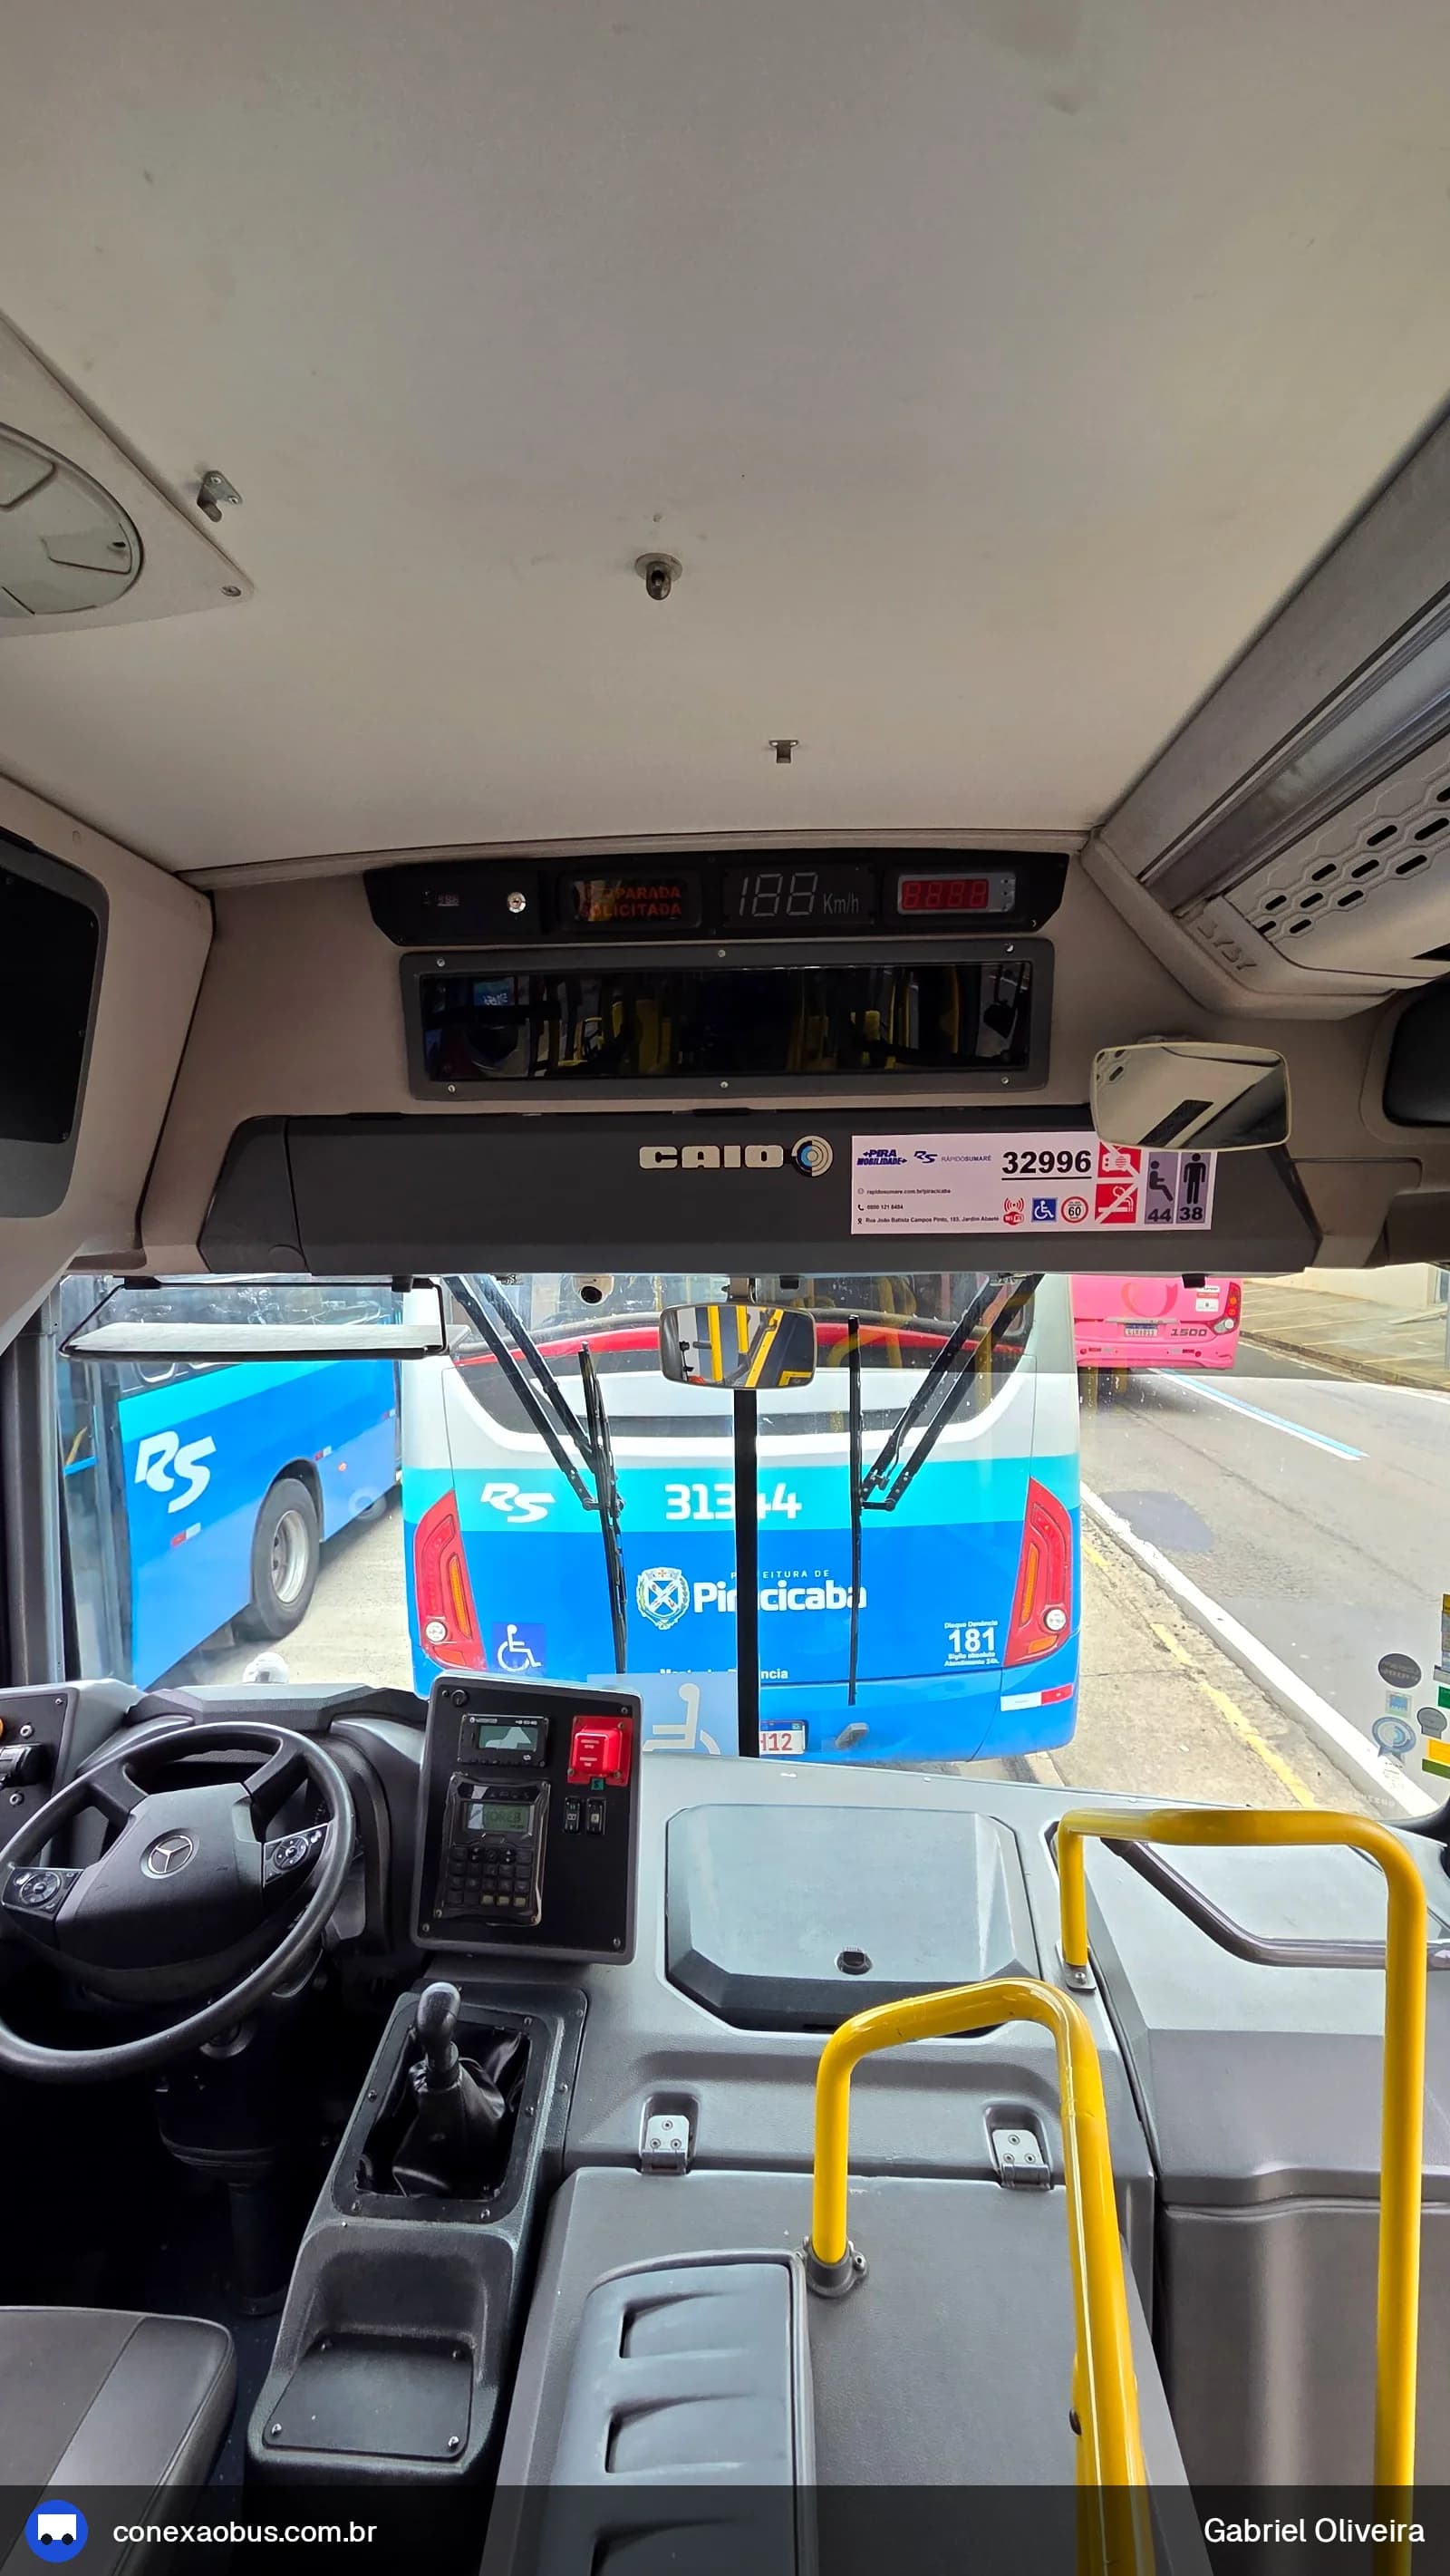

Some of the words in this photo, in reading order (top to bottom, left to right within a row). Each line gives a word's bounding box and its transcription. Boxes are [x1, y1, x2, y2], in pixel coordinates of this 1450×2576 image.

[615, 886, 682, 899] PARADA
[823, 893, 859, 915] Km/h
[639, 1146, 784, 1169] CAIO
[868, 1149, 897, 1157] PIRA
[1001, 1151, 1091, 1174] 32996
[1068, 1206, 1081, 1216] 60
[1147, 1208, 1173, 1222] 44
[1180, 1207, 1204, 1221] 38
[1171, 1329, 1207, 1337] 1500
[134, 1431, 217, 1513] RS
[480, 1482, 556, 1523] RS
[815, 1569, 830, 1578] DE
[948, 1627, 995, 1652] 181
